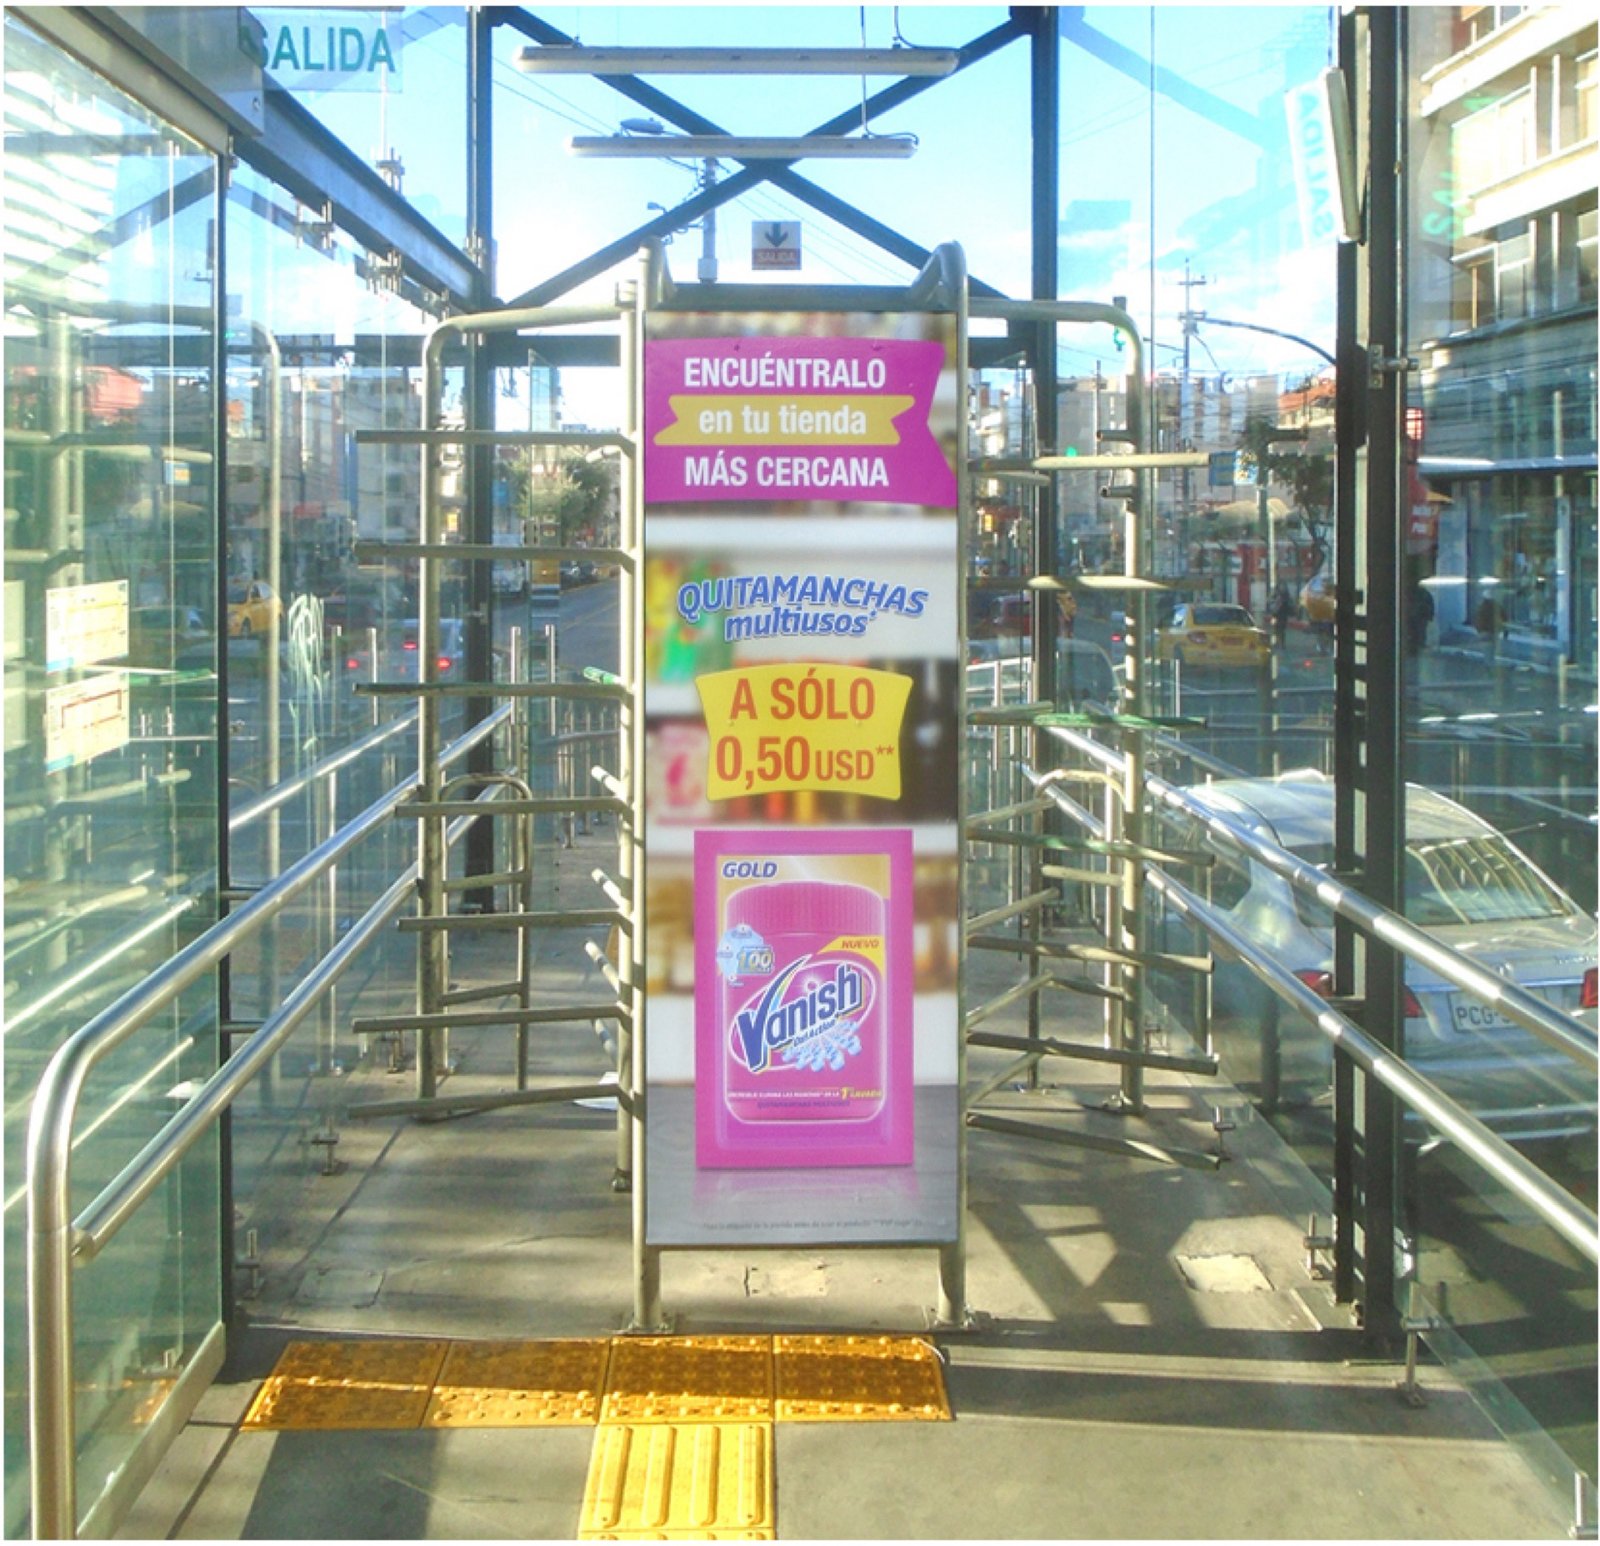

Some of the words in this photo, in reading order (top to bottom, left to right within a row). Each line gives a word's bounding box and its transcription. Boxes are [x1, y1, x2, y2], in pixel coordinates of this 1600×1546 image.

[683, 351, 886, 388] ENCUÉNTRALO
[699, 409, 732, 433] en
[742, 406, 770, 434] tu
[779, 405, 867, 434] tienda
[684, 450, 748, 486] MÁS
[757, 457, 889, 486] CERCANA
[677, 575, 929, 623] QUITAMANCHAS
[730, 678, 758, 720] A
[770, 668, 875, 720] SÓLO
[716, 735, 811, 790] 0,50
[722, 861, 778, 879] GOLD
[738, 950, 771, 969] 100
[841, 938, 881, 950] NUEVO
[736, 962, 864, 1074] Vanish
